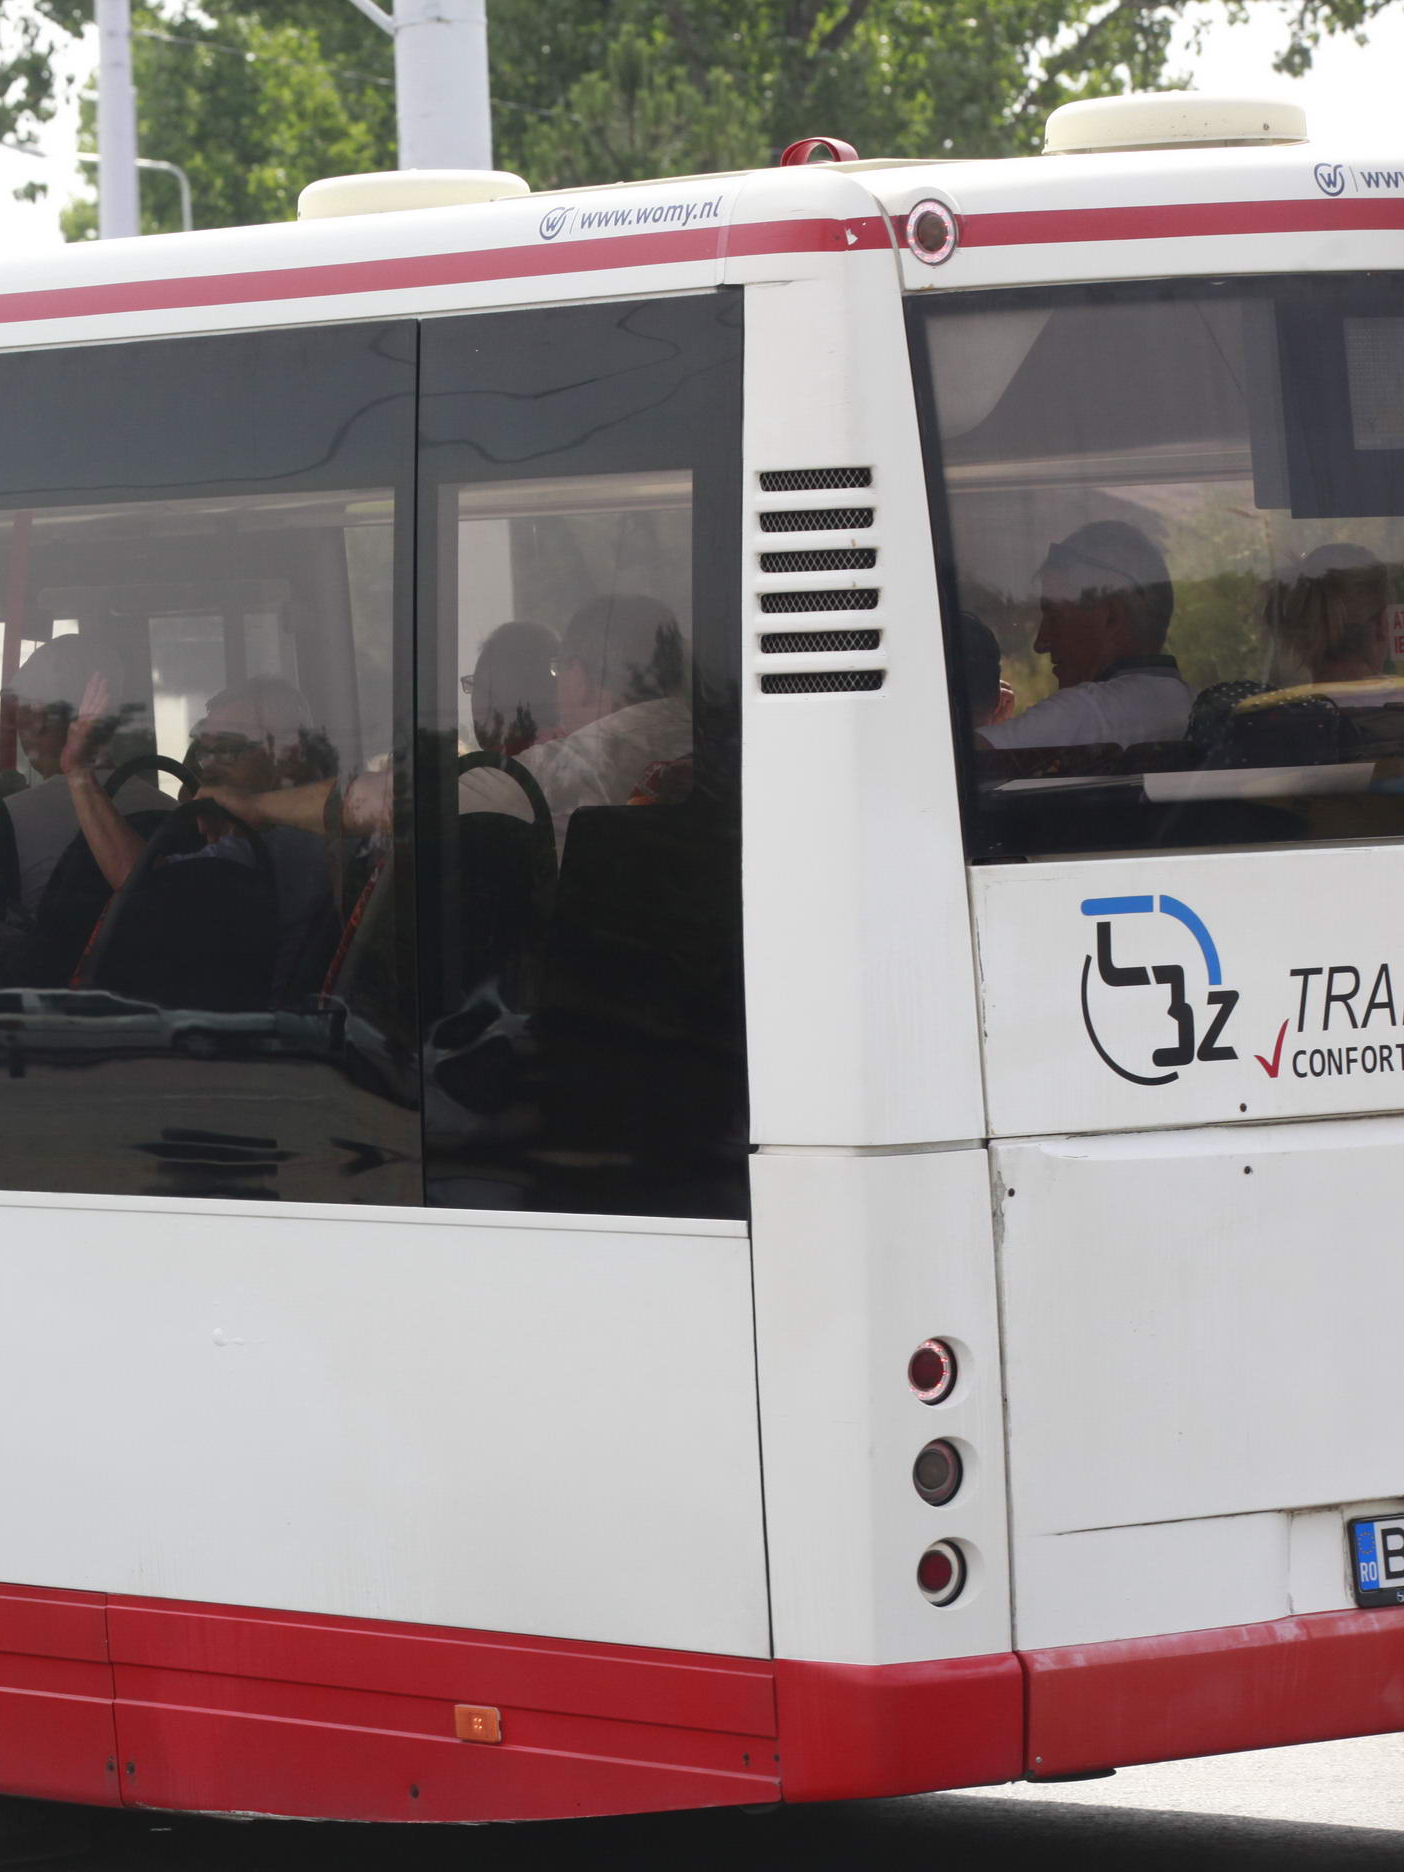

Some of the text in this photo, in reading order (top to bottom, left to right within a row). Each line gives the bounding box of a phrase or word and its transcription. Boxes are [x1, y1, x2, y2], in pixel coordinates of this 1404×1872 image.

[580, 195, 723, 227] www.womy.nl
[1290, 963, 1404, 1033] TRA
[1359, 1561, 1378, 1582] RO
